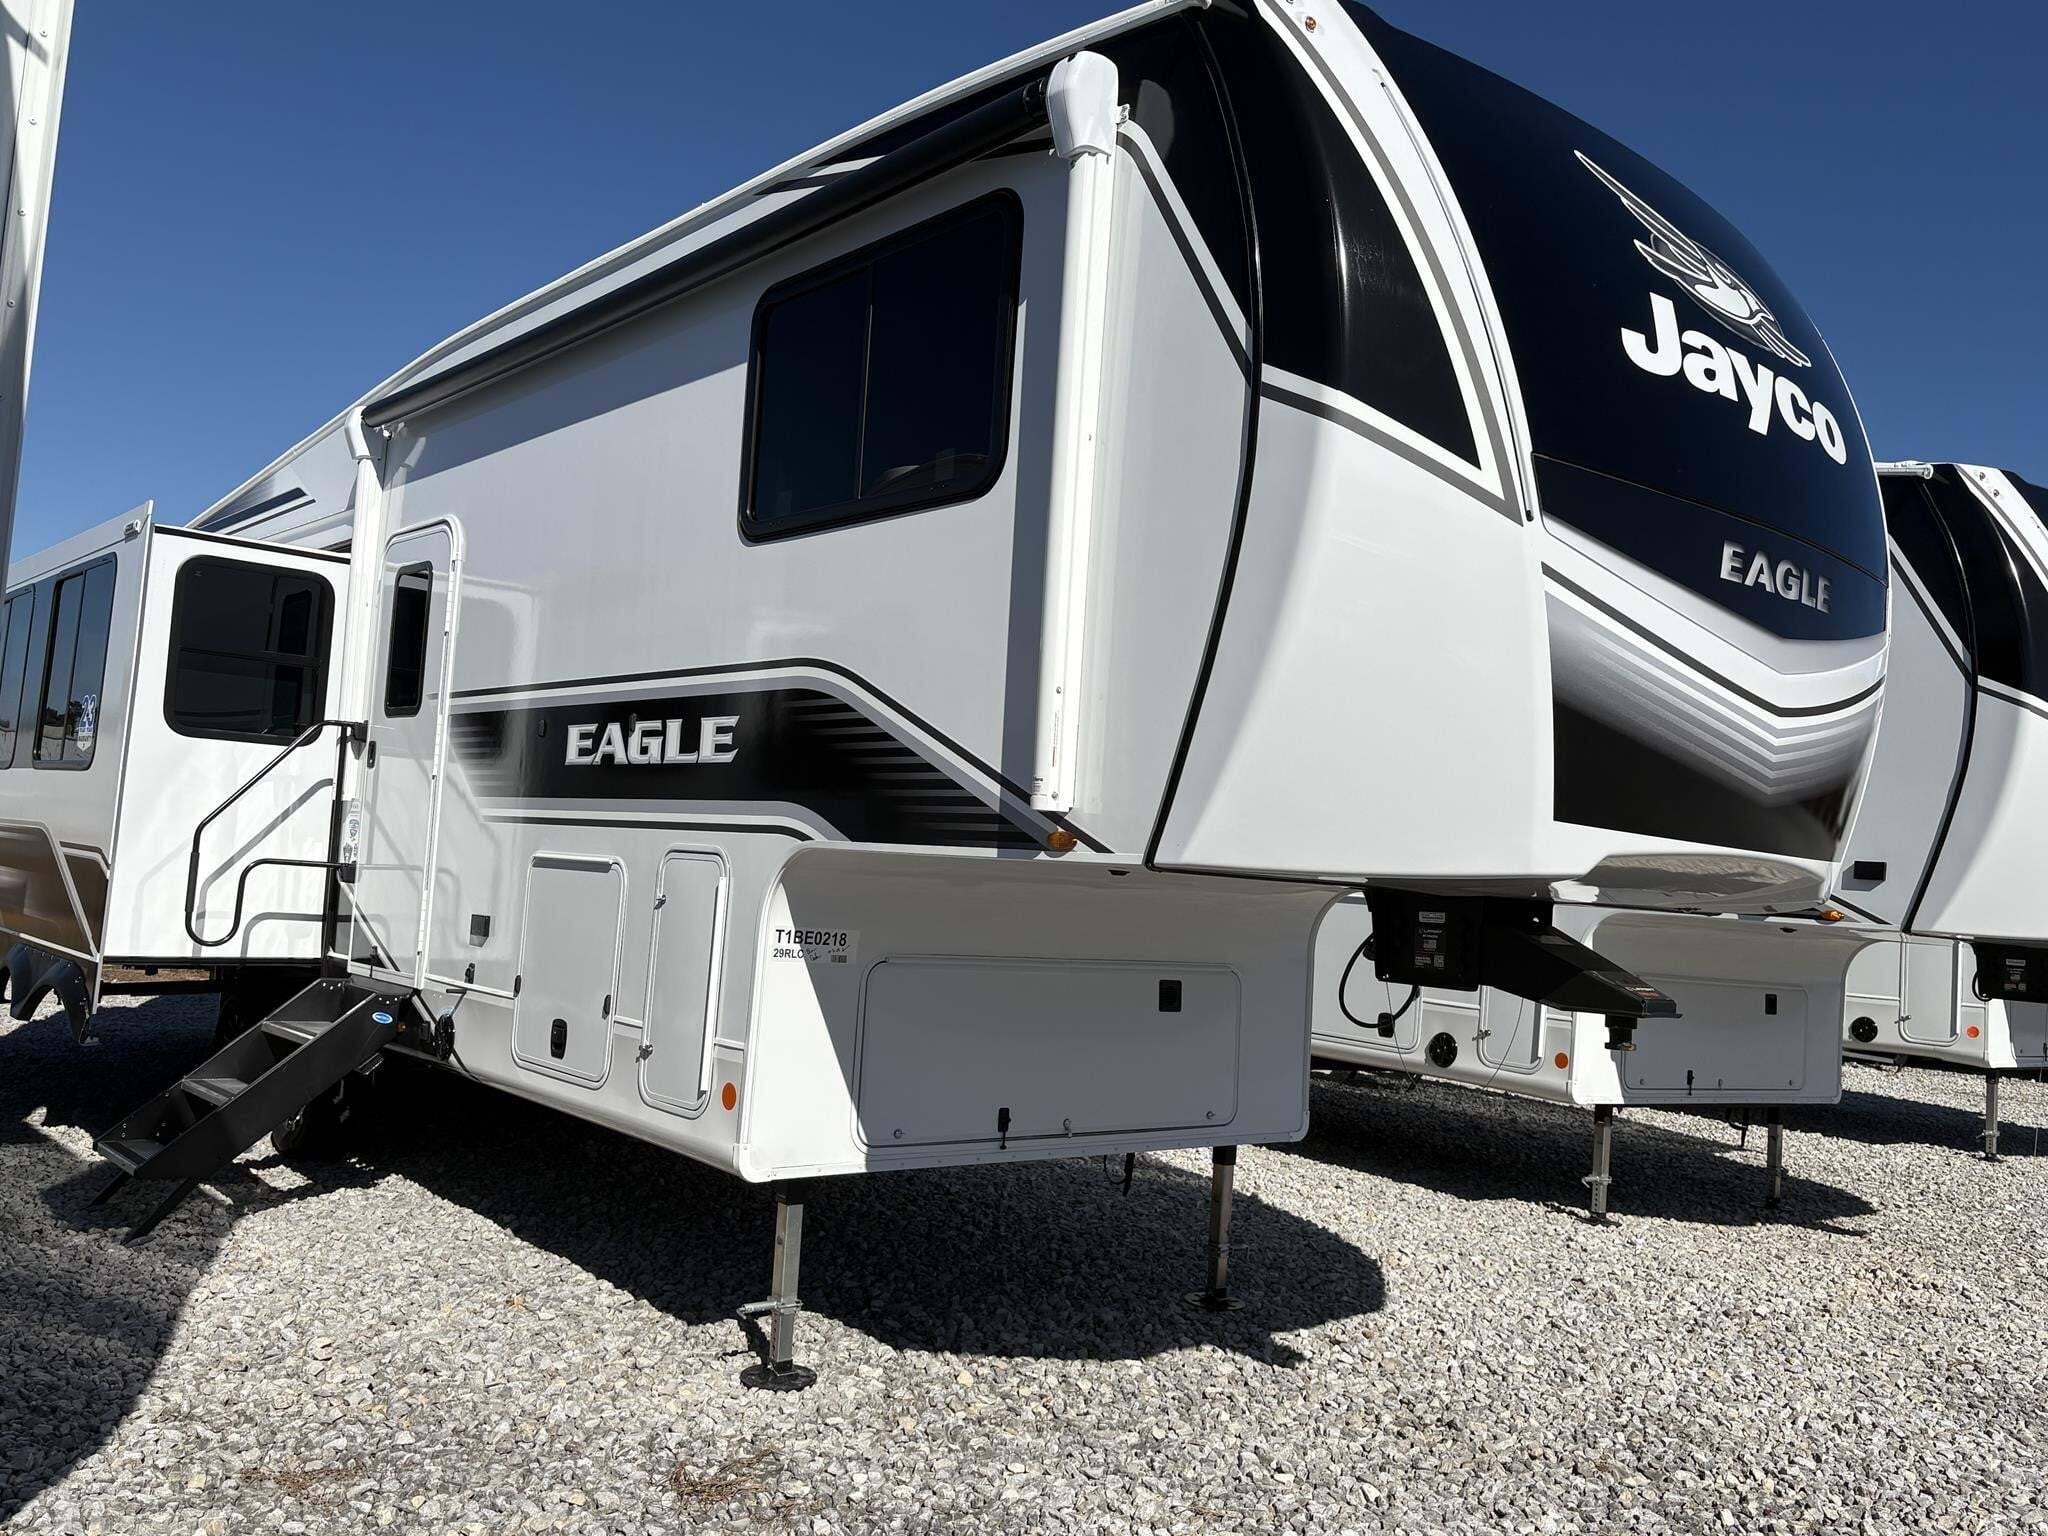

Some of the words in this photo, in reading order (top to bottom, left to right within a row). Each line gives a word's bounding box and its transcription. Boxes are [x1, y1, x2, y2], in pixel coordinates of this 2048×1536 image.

[1621, 292, 1847, 465] Jayco
[1720, 540, 1833, 614] EAGLE
[564, 715, 740, 766] EAGLE
[775, 929, 847, 947] T1BE0218
